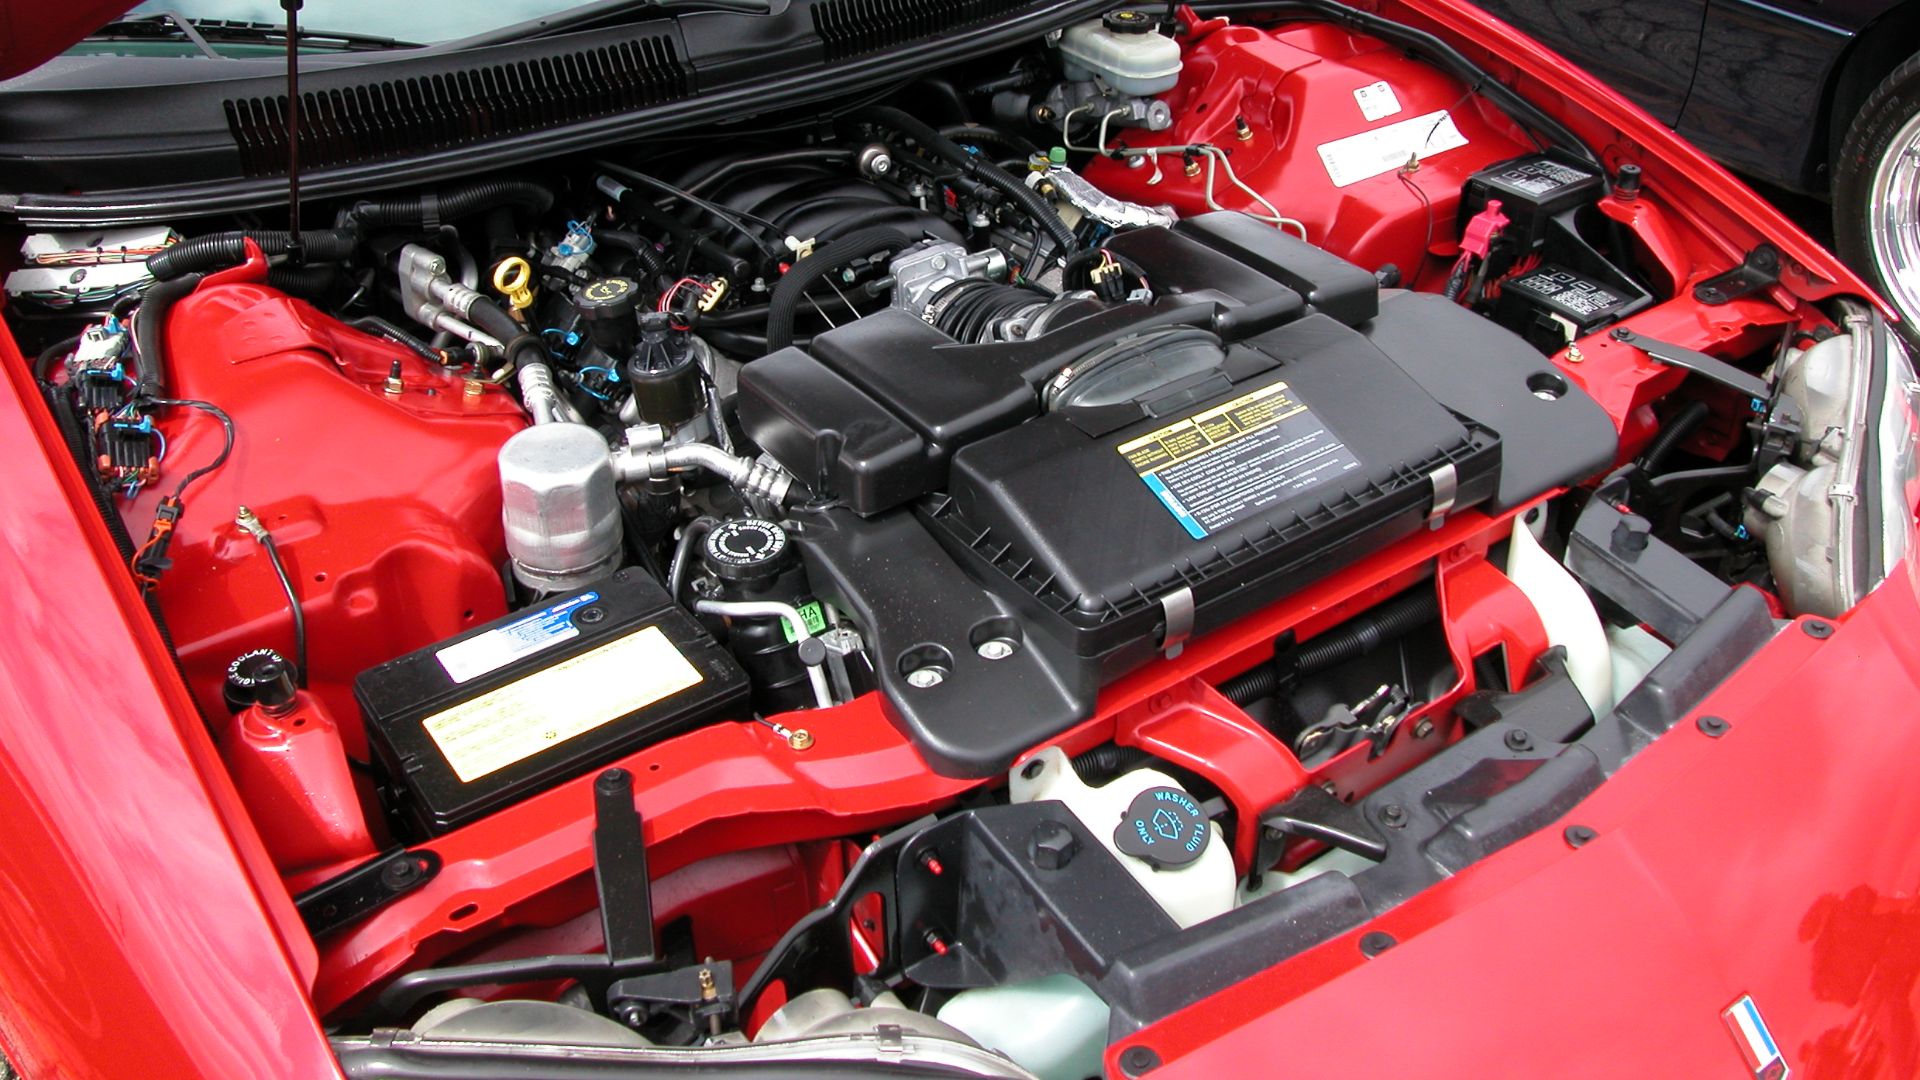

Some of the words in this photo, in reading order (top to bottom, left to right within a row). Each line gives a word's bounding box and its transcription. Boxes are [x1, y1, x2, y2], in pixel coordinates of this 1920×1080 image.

[228, 648, 273, 672] COOLANT
[1155, 791, 1199, 817] WASHER
[1135, 820, 1155, 845] ONLY
[1186, 823, 1204, 852] FLUID
